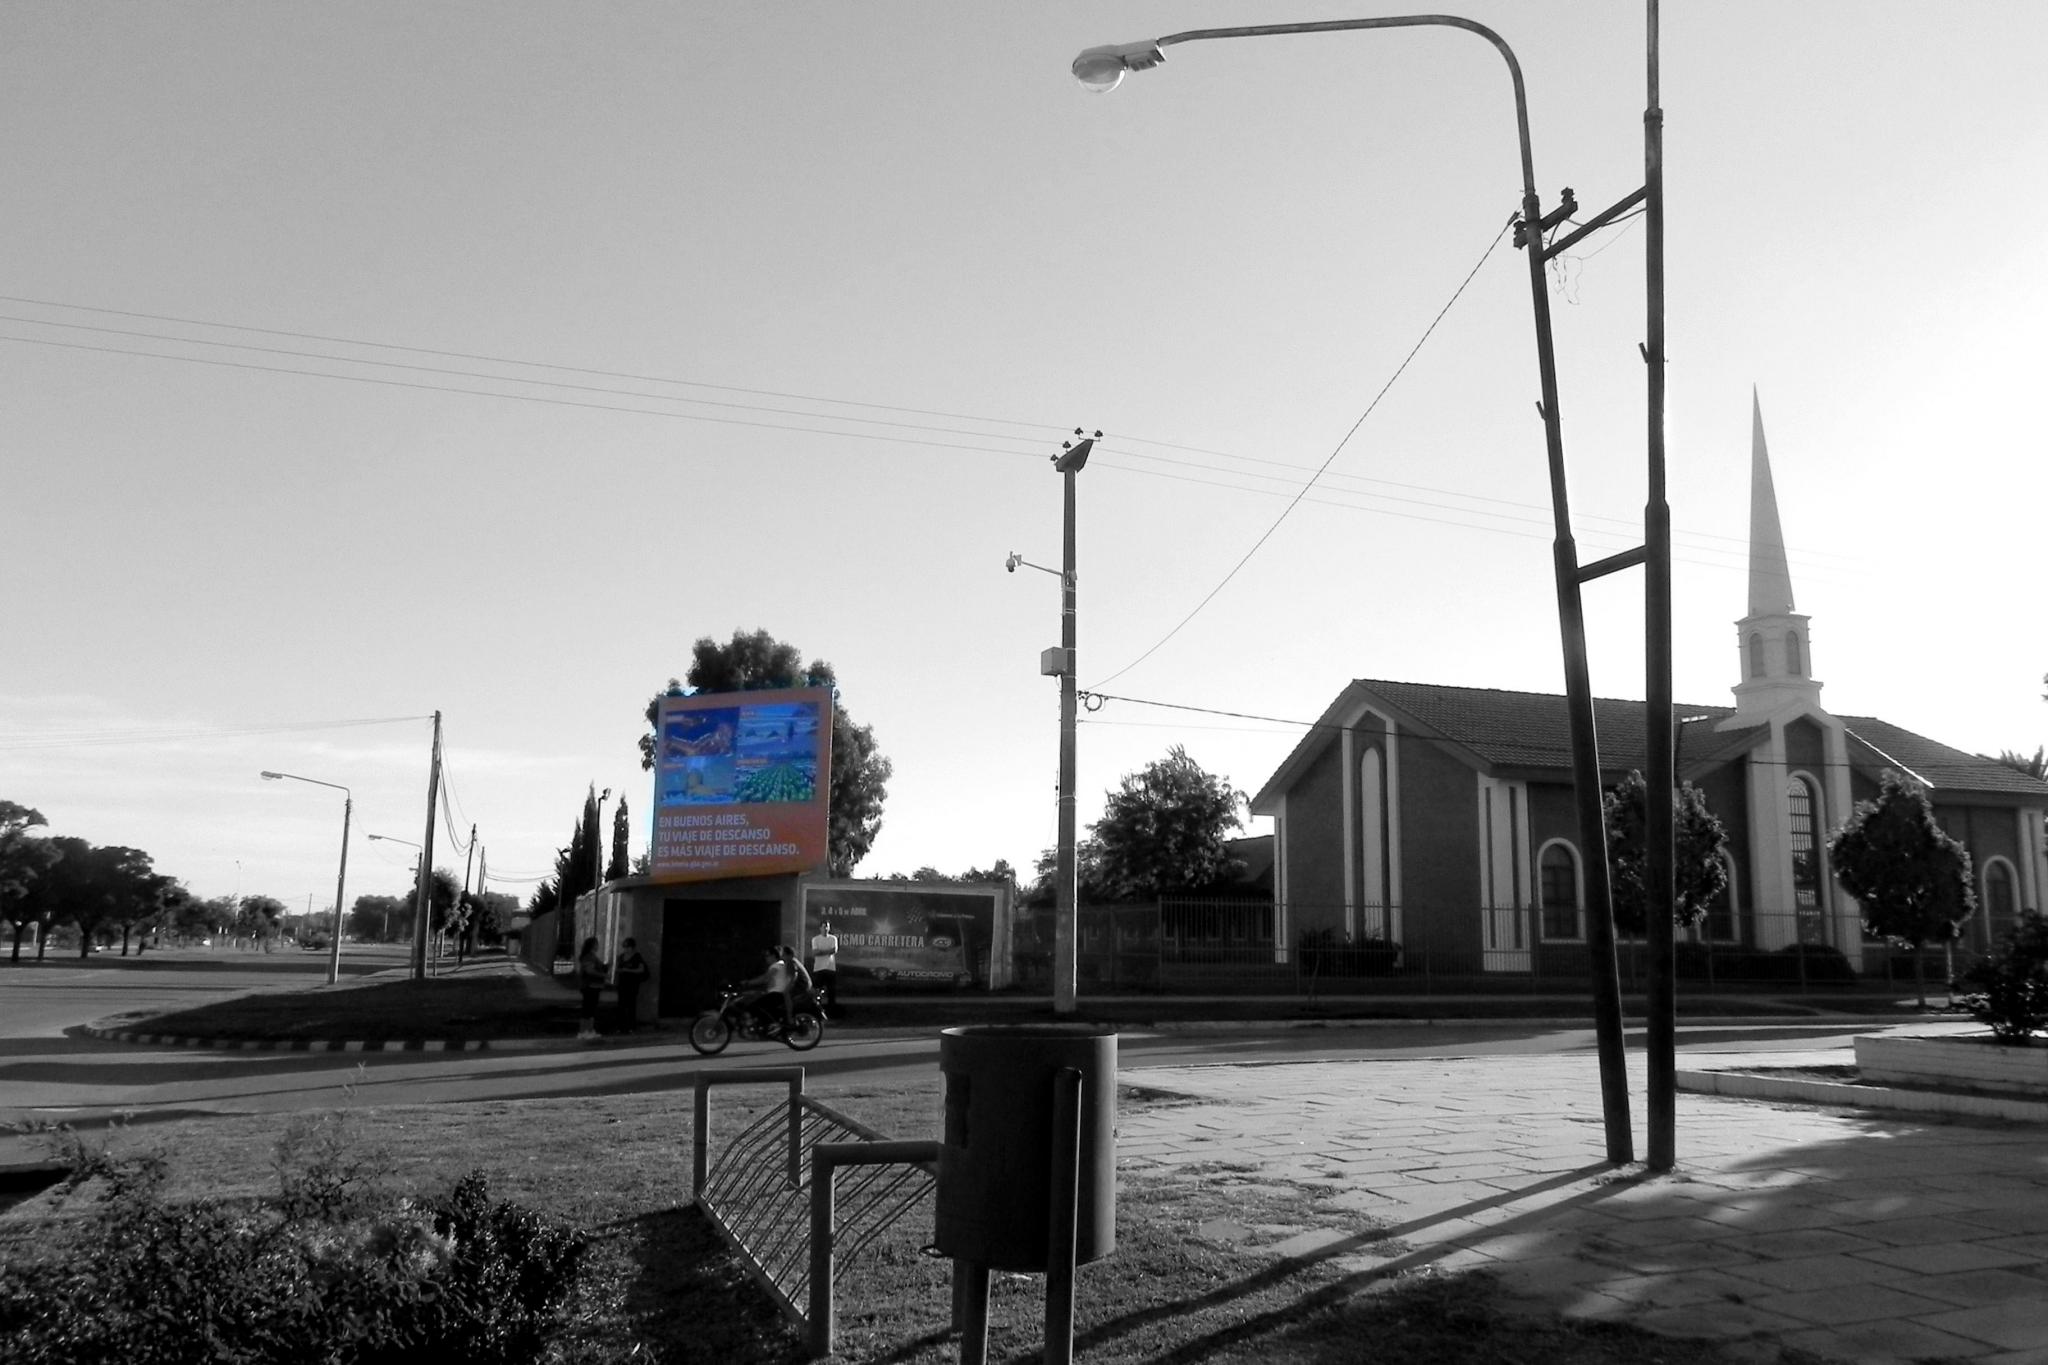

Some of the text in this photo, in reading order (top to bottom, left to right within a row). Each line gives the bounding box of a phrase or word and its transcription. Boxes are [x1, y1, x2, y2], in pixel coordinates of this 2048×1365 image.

[659, 817, 672, 828] EN
[673, 815, 713, 827] BUENOS
[658, 828, 771, 844] TU VIAJE DE DESCANSO
[657, 843, 800, 858] ES MÁS VIAJE DE DESCANSO.
[867, 934, 925, 948] CARRETERA
